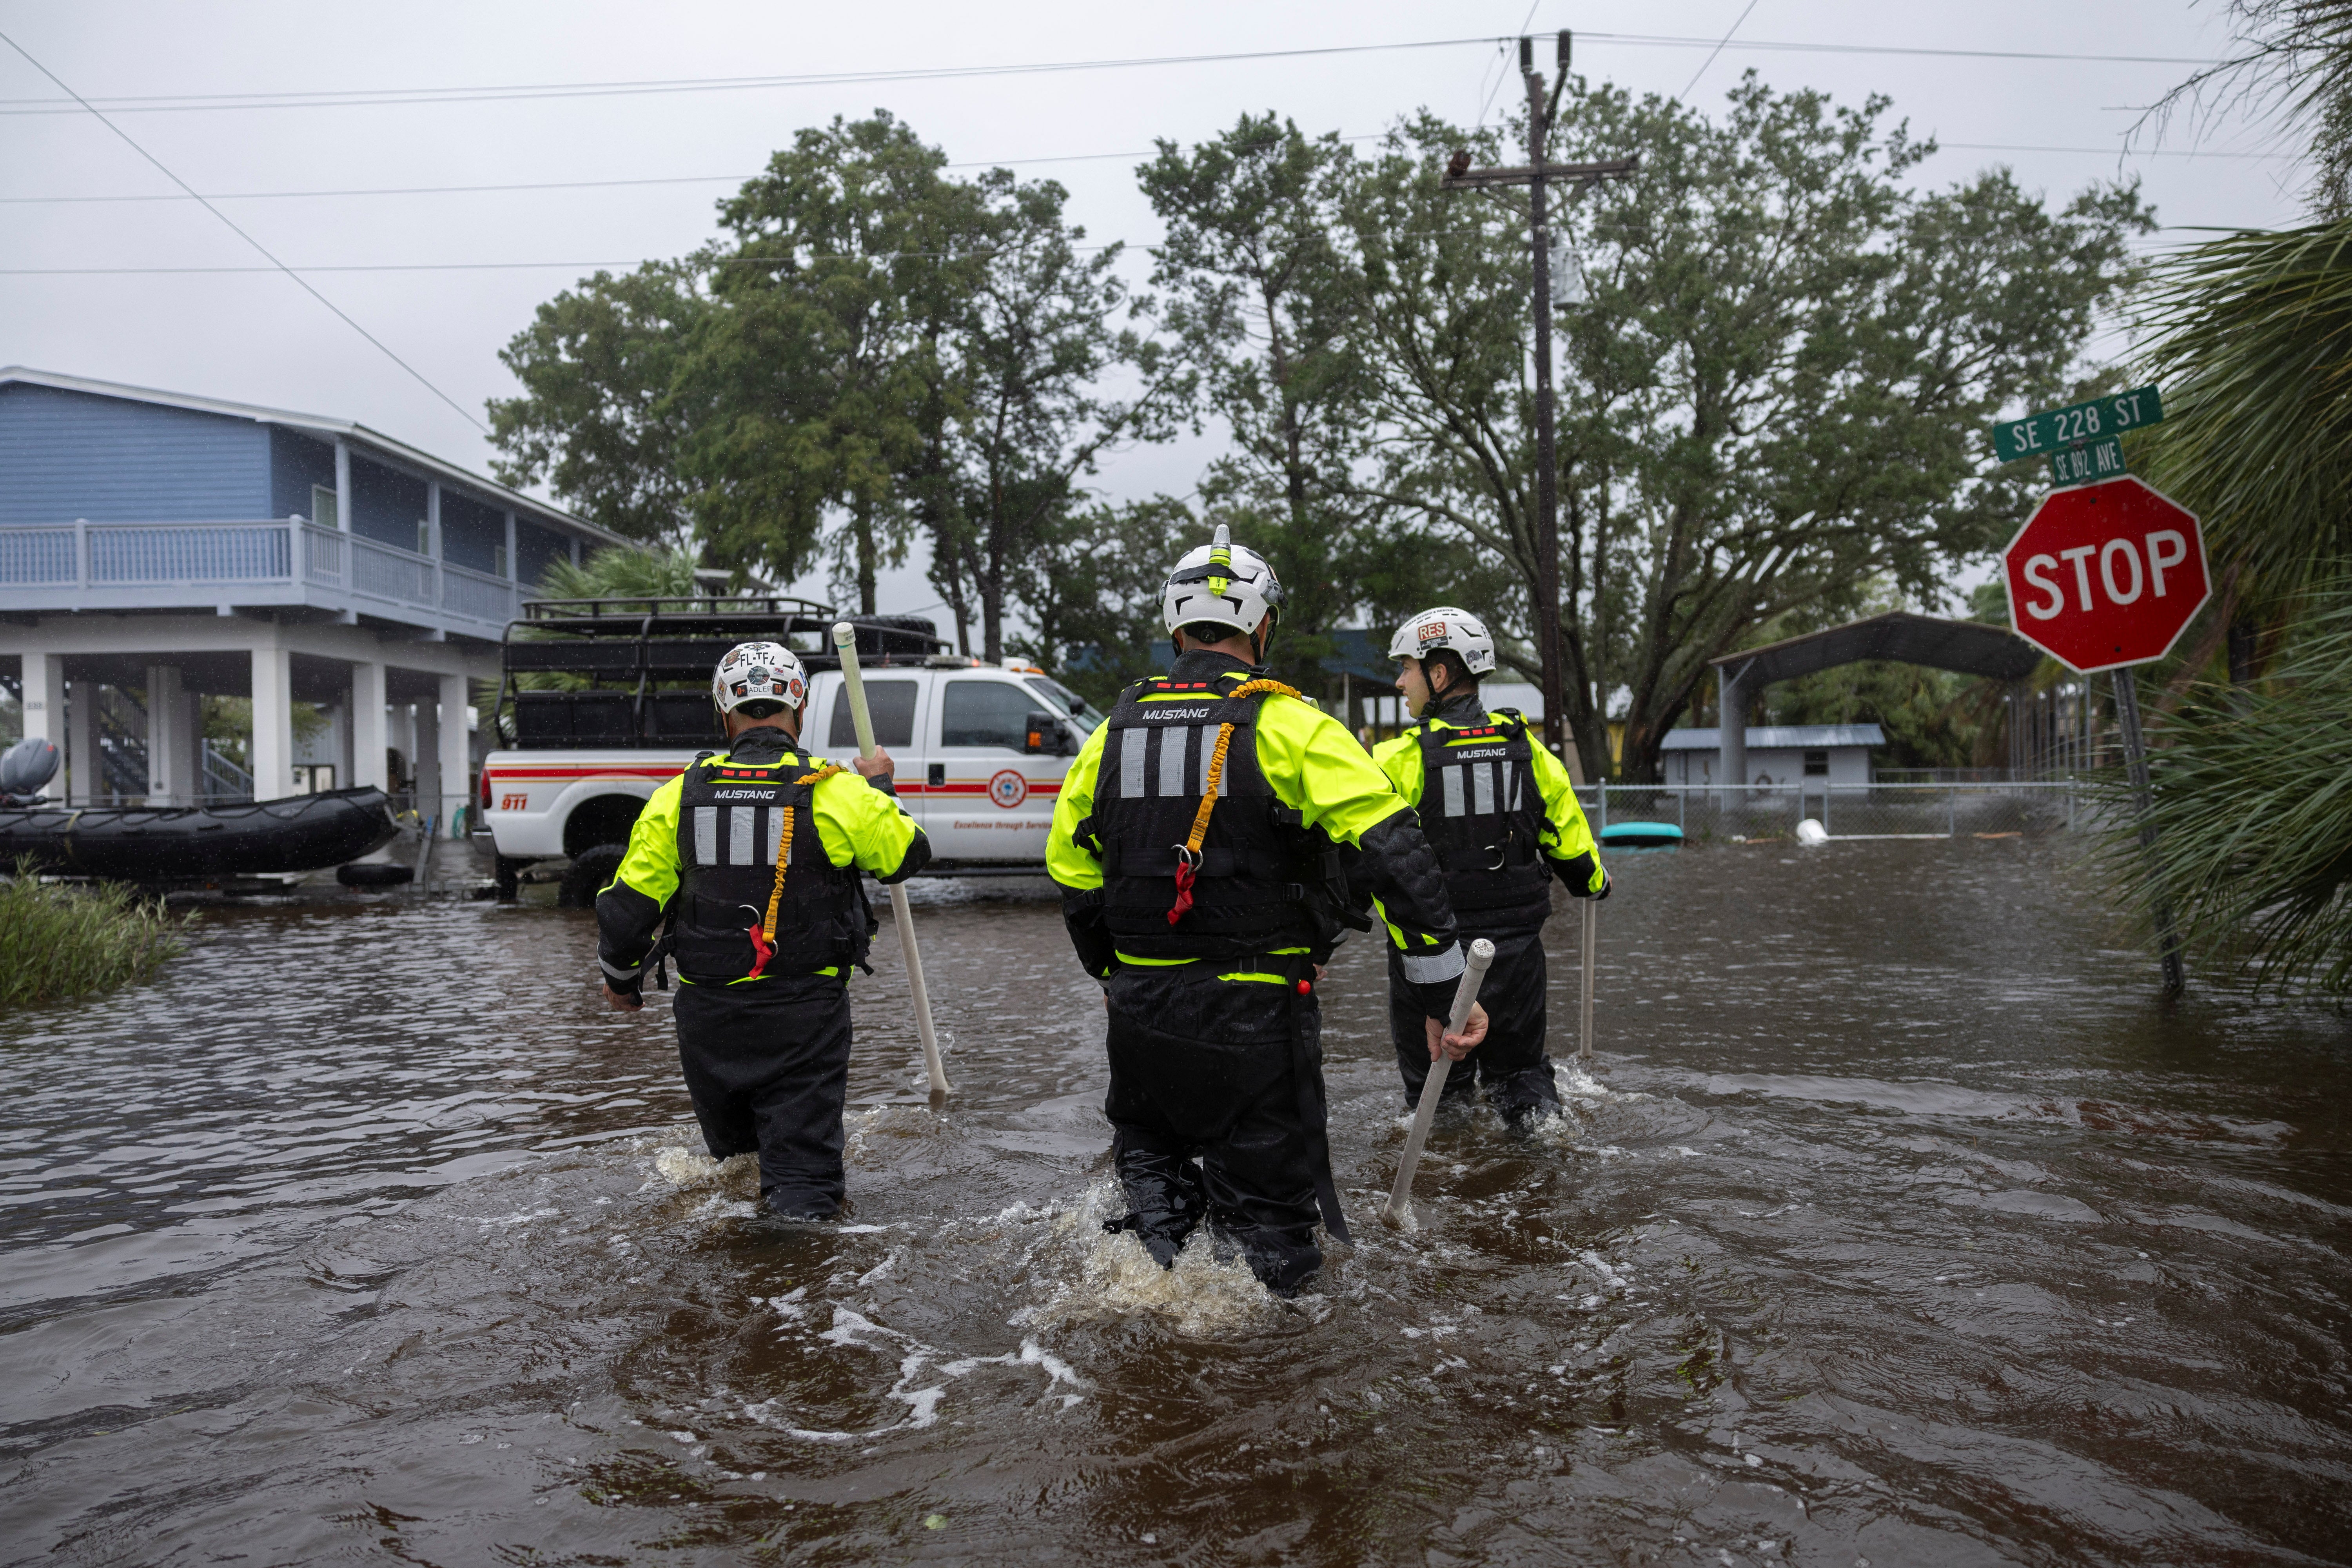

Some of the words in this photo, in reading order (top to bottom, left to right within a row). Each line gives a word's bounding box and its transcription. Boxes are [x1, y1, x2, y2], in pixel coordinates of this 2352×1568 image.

[2012, 420, 2042, 452] SE
[2054, 406, 2101, 442] 228
[2114, 395, 2141, 426] ST
[2055, 454, 2070, 481] SE
[2096, 441, 2120, 473] AVE
[2024, 529, 2187, 621] STOP
[1419, 622, 1444, 639] RES
[1142, 708, 1209, 720] MUSTANG
[1457, 748, 1506, 759] MUSTANG
[714, 790, 776, 799] MUSTANG
[501, 799, 527, 810] 911
